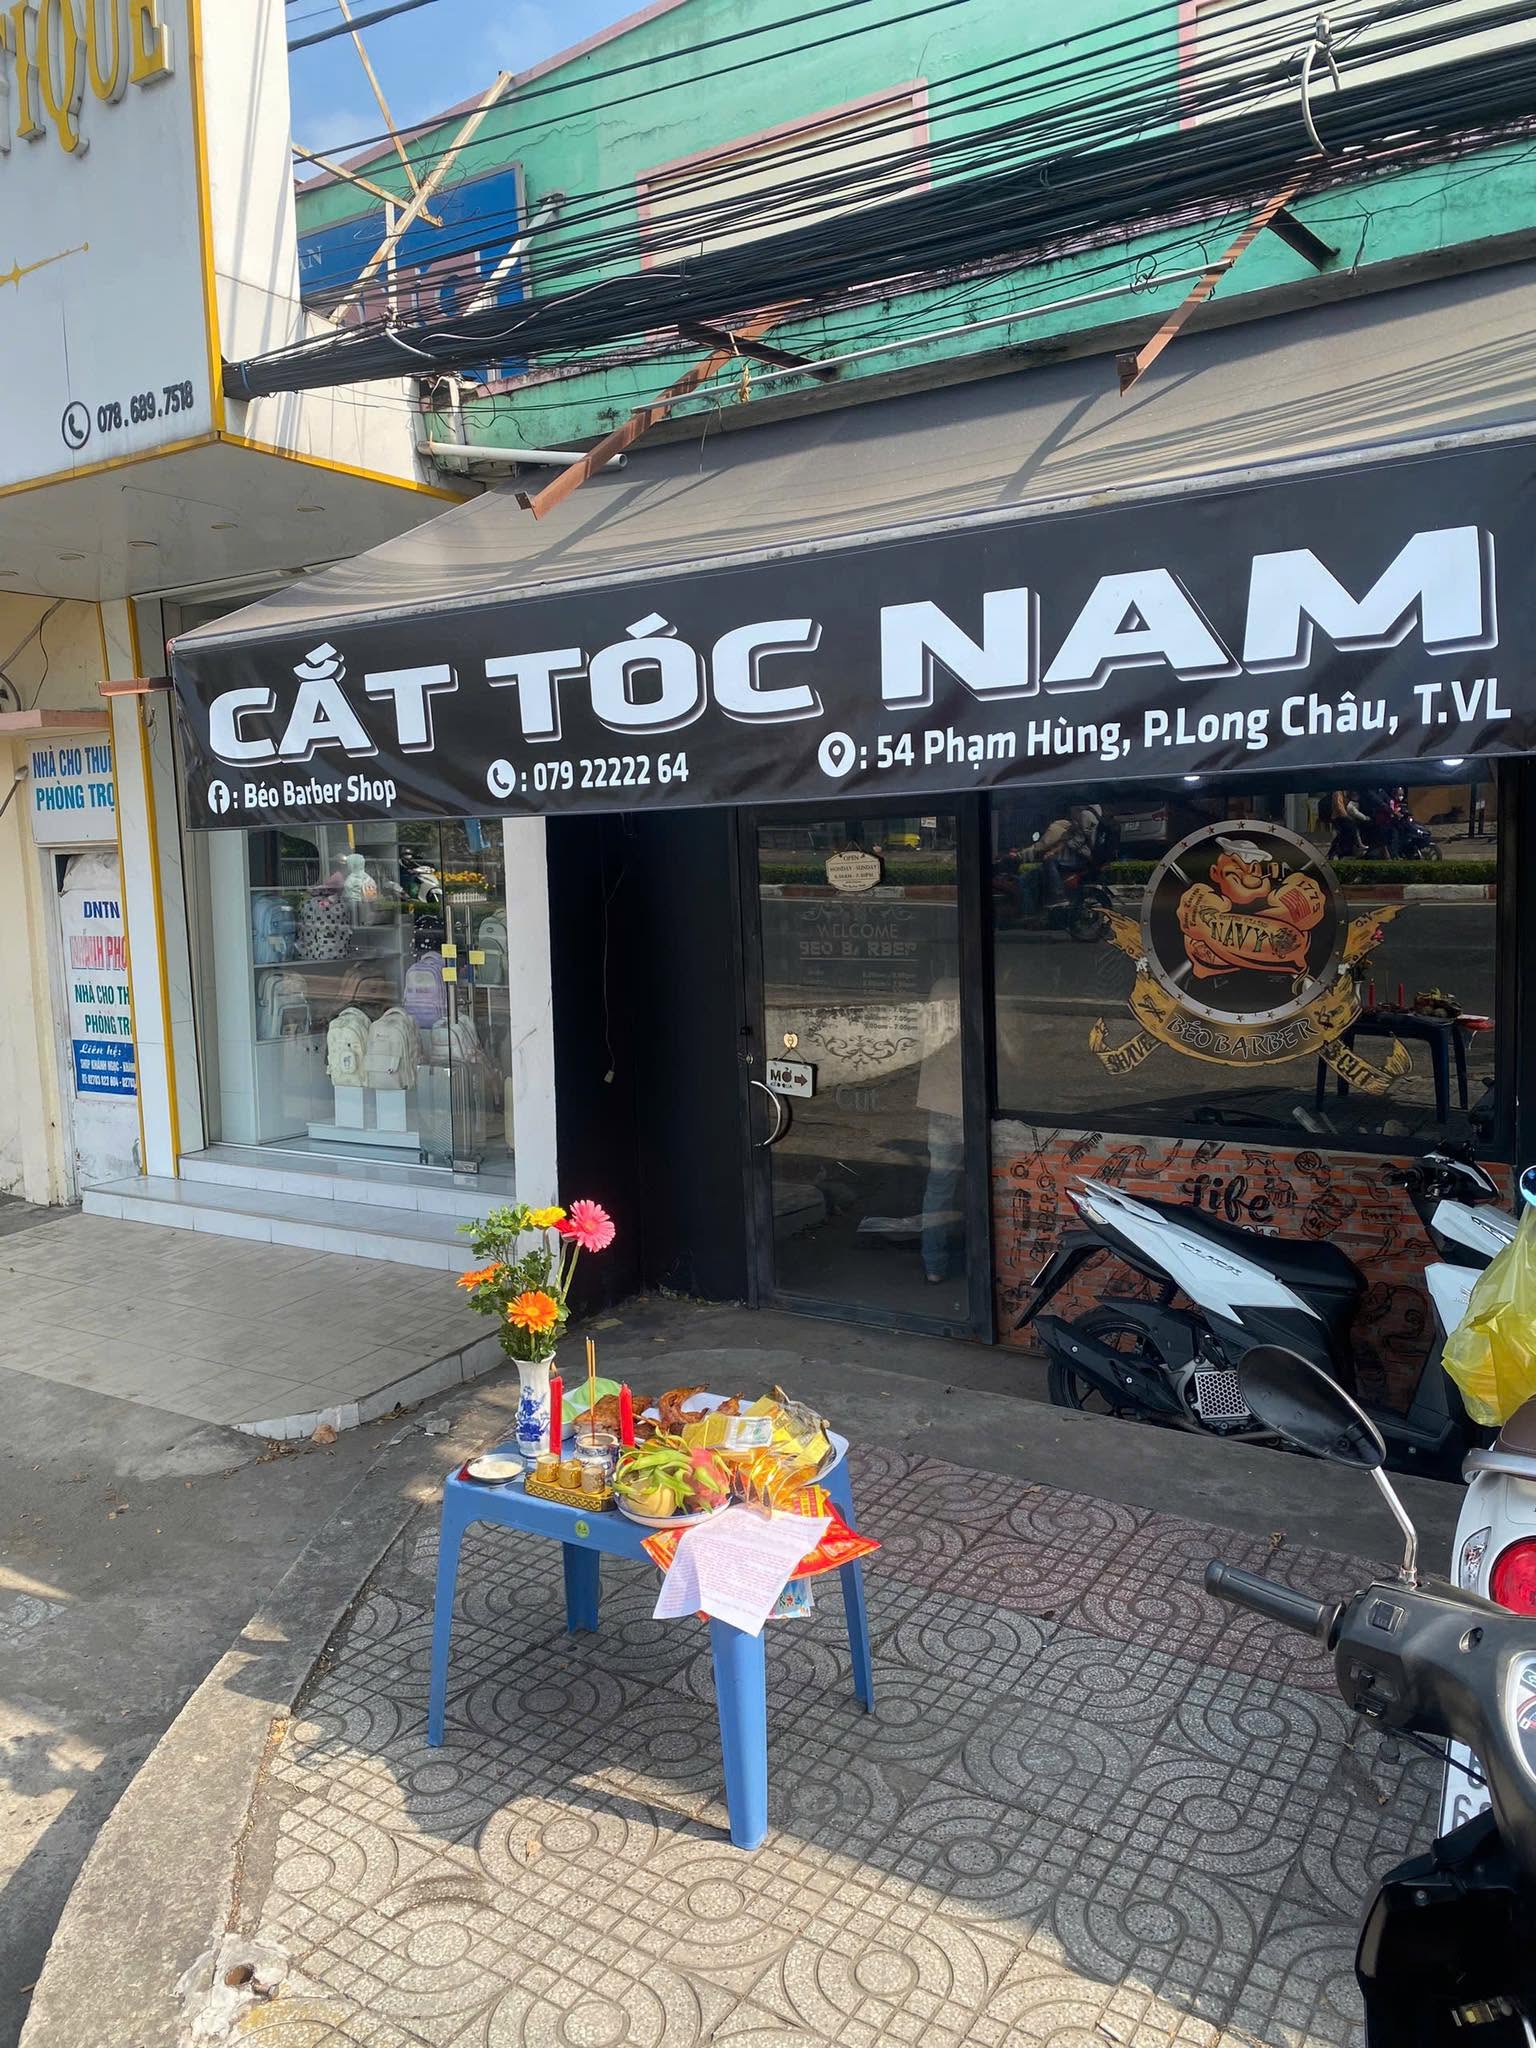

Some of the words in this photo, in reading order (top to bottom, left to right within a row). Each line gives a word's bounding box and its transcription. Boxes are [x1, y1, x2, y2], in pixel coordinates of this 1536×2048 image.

[0, 0, 173, 154] IQUE
[97, 380, 194, 433] 078.689.7518
[209, 641, 459, 767] CẮT
[485, 612, 824, 744] TÓC
[881, 525, 1499, 711] NAM
[877, 733, 915, 769] 54
[924, 726, 1016, 770] Phạm
[1027, 716, 1131, 762] Hùng,
[1143, 707, 1270, 750] P.Long
[1281, 690, 1400, 737] Châu,
[1413, 677, 1512, 726] T.VL
[32, 744, 57, 779] NHÀ
[59, 748, 82, 777] CHO
[533, 761, 574, 791] 079
[580, 754, 651, 788] 22222
[657, 751, 689, 784] 64
[36, 780, 85, 811] PHÒNG
[244, 780, 279, 809] Béo
[283, 777, 342, 806] Barber
[347, 774, 397, 808] Shop
[84, 901, 120, 919] DNTN
[1210, 918, 1267, 954] NAVY
[74, 980, 96, 1004] NHÀ
[96, 985, 115, 1005] CHO
[84, 1010, 117, 1035] PHÒNG
[1166, 1014, 1214, 1049] BÉO
[1213, 1018, 1320, 1060] BARBER
